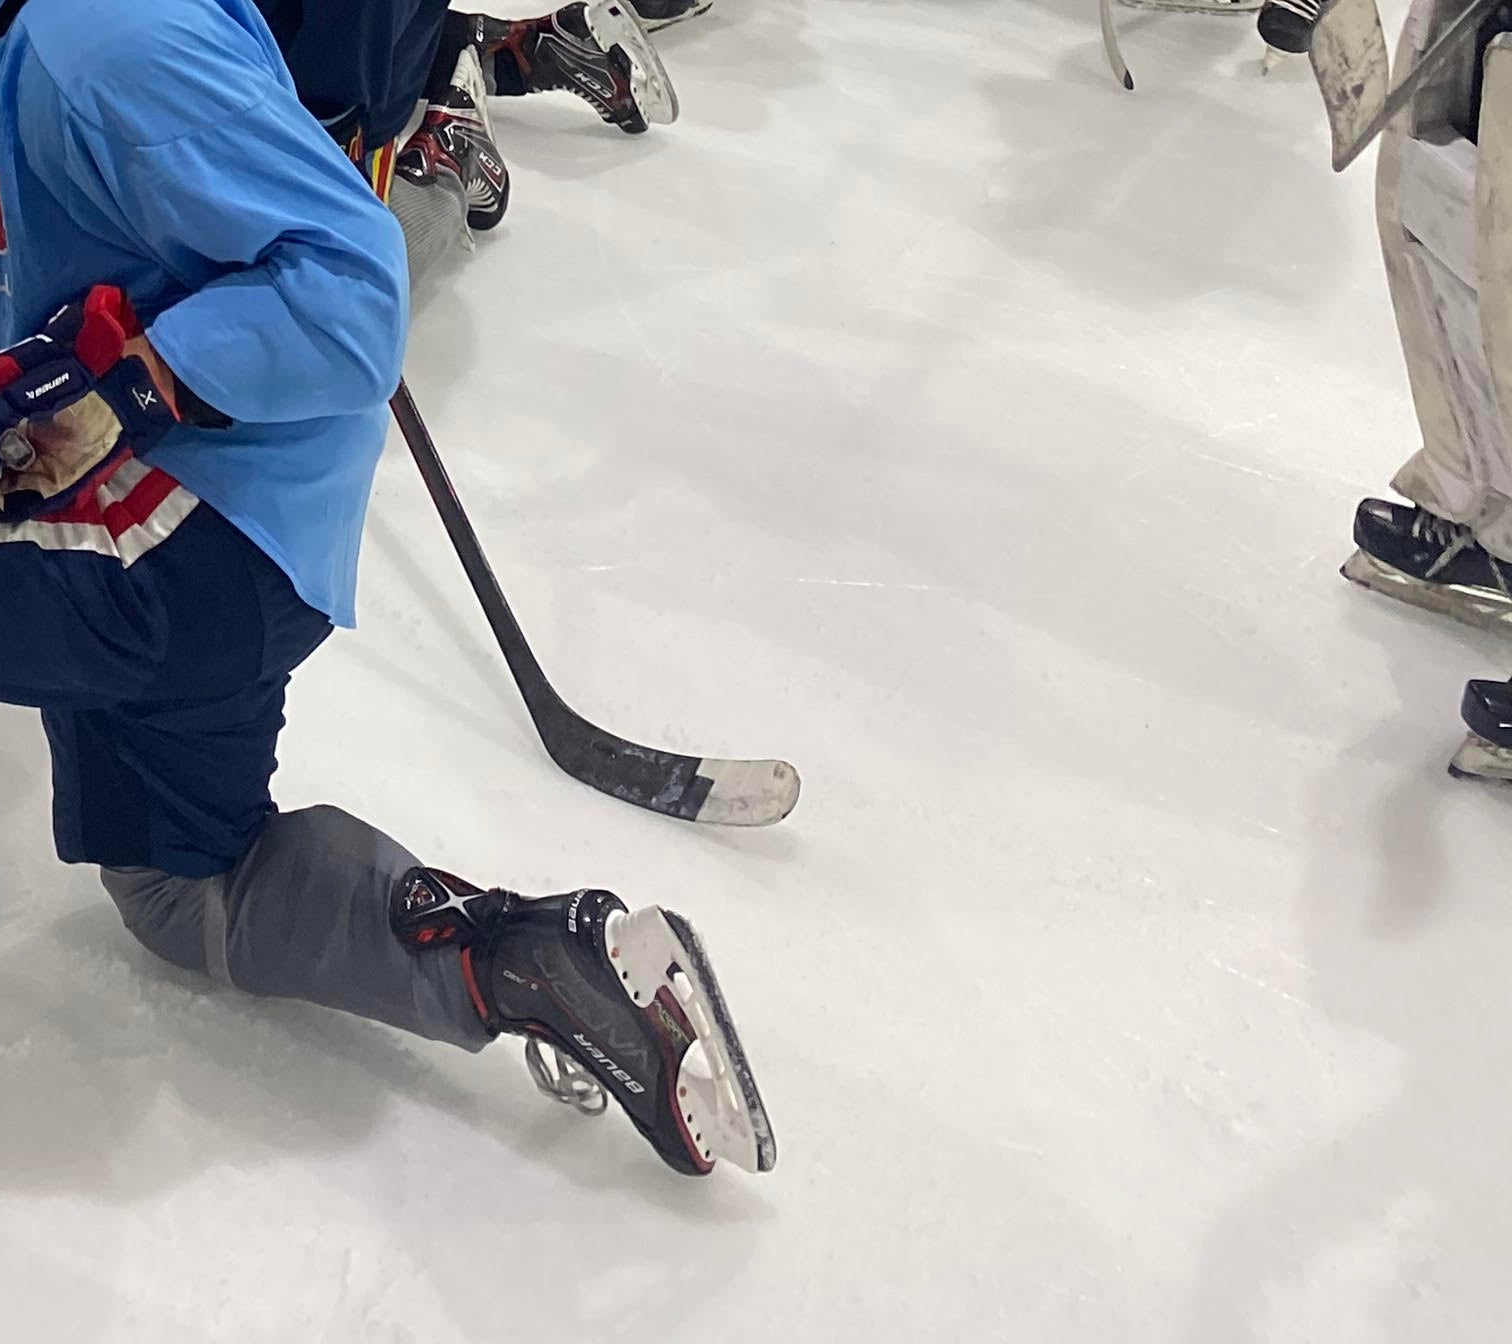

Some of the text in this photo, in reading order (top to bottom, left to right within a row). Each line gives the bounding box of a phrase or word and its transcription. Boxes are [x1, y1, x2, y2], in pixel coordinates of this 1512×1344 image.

[572, 71, 613, 99] CCM
[477, 151, 503, 177] CCM
[32, 371, 71, 399] BAUER
[572, 1032, 646, 1095] BAUER
